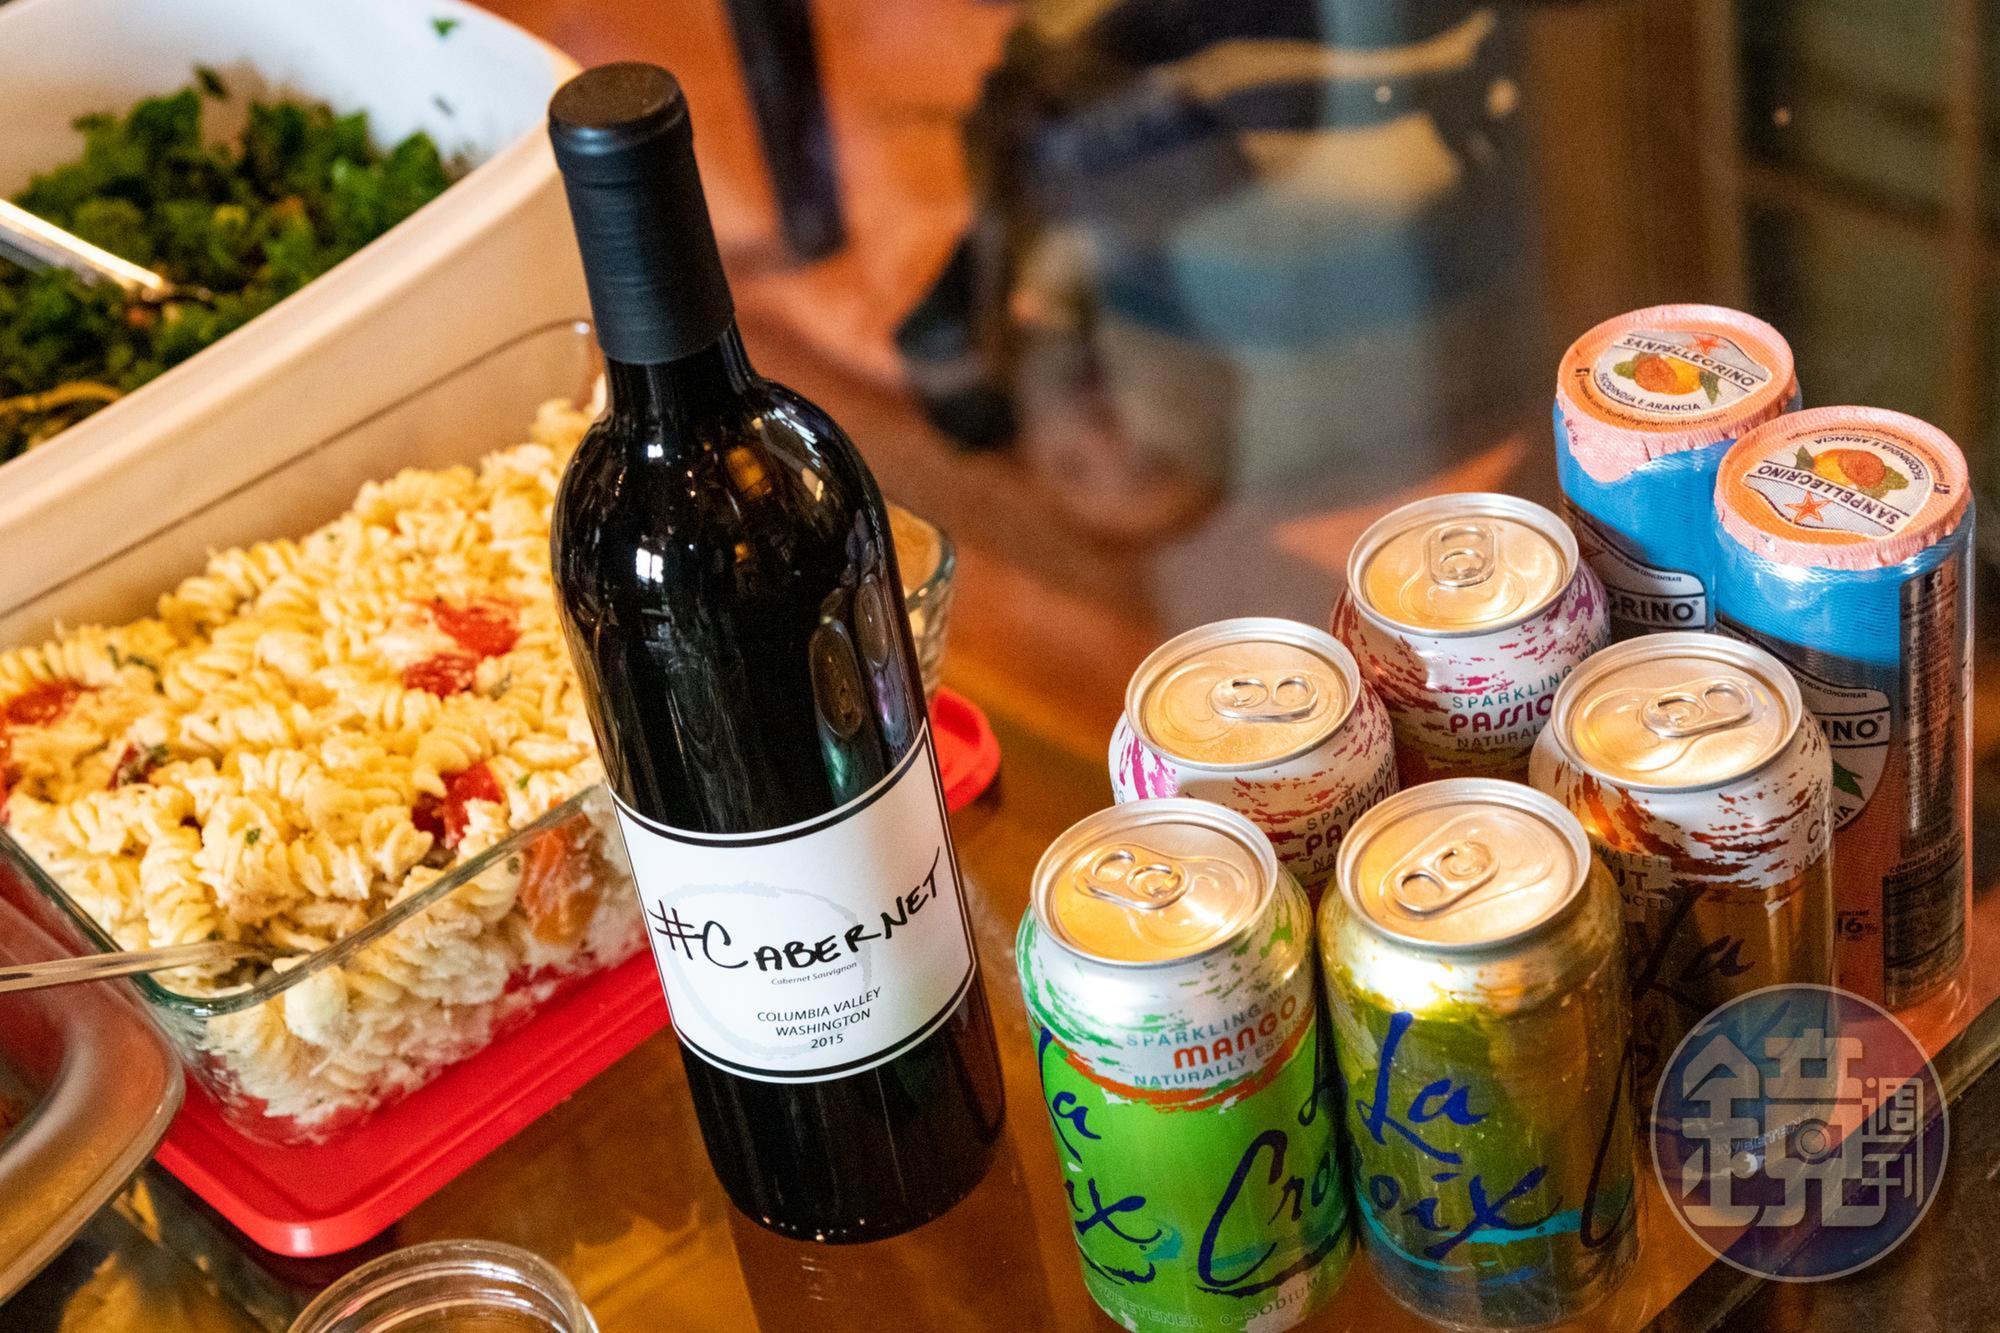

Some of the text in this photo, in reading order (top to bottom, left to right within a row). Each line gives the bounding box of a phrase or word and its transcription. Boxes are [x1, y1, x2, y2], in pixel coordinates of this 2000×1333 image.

[1622, 336, 1756, 387] SANPELLEGRINO
[1647, 402, 1702, 412] ARANCIA
[1814, 435, 1869, 446] ARANCIA
[1757, 464, 1901, 526] SANPELLEGRINO
[1451, 664, 1573, 709] SPARKLING
[1306, 752, 1390, 831] SPARKLING
[771, 961, 858, 986] Cabernet Sauvignon
[756, 986, 883, 1023] COLUMBIA VALLEY
[775, 1008, 871, 1037] WASHINGTON
[811, 1034, 844, 1049] 2015
[1126, 1003, 1261, 1047] SPARKLING
[1173, 994, 1297, 1069] MANGO
[1134, 1054, 1247, 1087] NATURALLY
[1356, 1011, 1489, 1164] La
